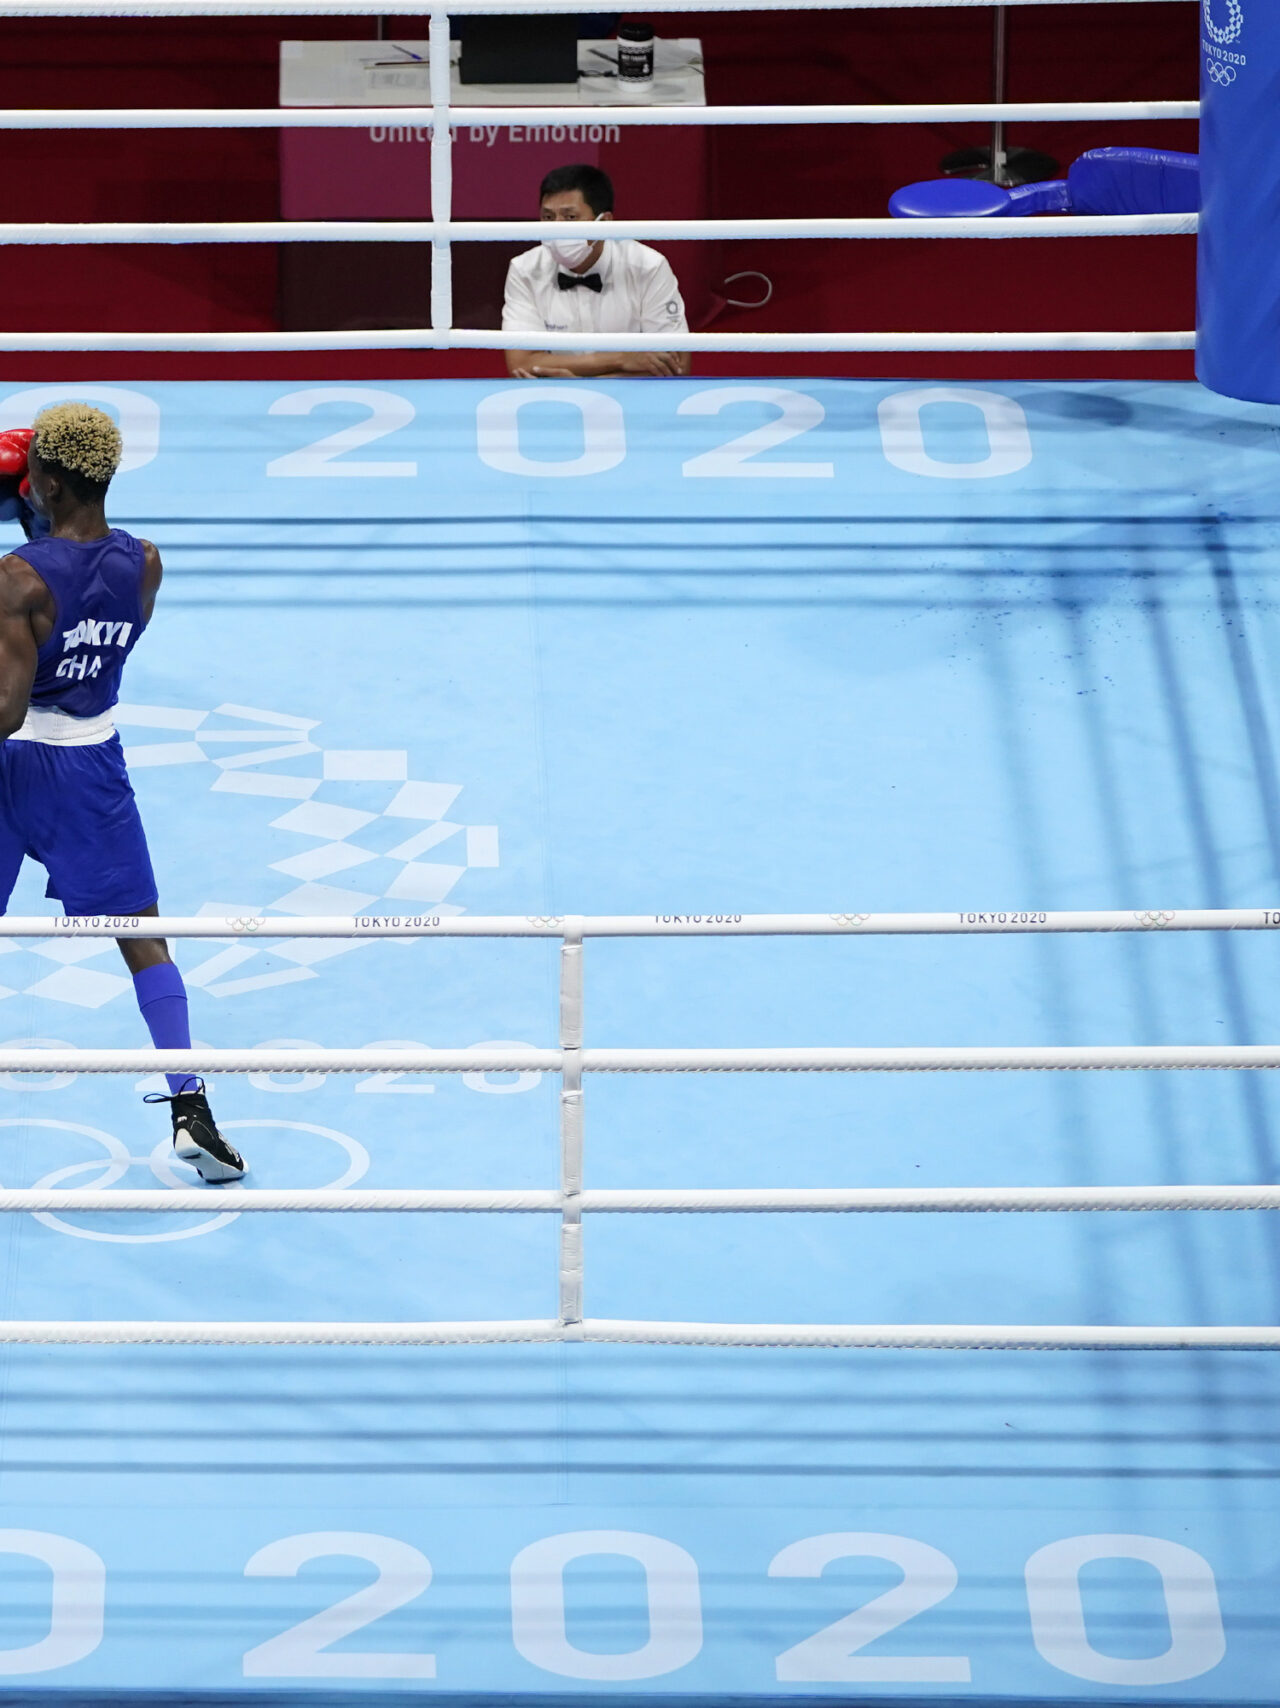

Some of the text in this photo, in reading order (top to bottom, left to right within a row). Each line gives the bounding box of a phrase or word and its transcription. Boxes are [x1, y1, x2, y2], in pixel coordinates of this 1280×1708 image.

[1202, 39, 1246, 66] TOKYO 2020
[470, 125, 497, 147] by
[509, 125, 621, 143] Emotion
[265, 386, 1033, 479] 2020
[53, 916, 140, 928] TOKYO 2020
[353, 916, 441, 928] TOKYO 2020
[654, 914, 742, 924] TOKYO 2020
[958, 912, 1047, 924] TOKYO 2020
[133, 1038, 543, 1094] 020
[241, 1530, 1228, 1687] 2020
